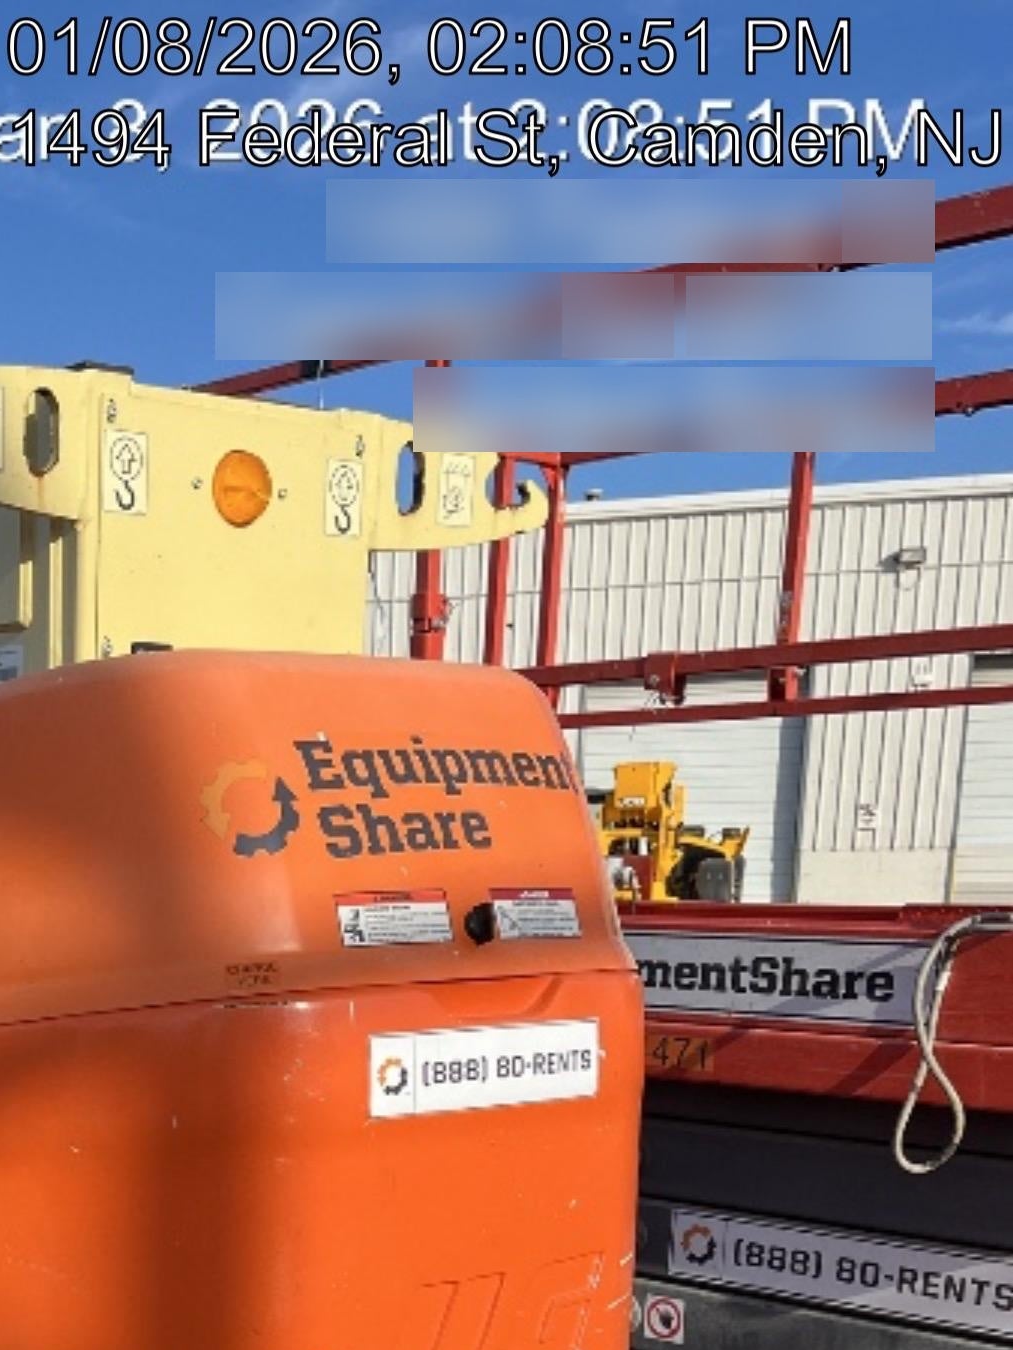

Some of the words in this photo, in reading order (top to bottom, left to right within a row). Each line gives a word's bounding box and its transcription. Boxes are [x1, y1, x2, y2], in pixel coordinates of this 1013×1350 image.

[293, 733, 579, 799] Equipmen
[316, 802, 493, 859] Share
[732, 1237, 823, 1289] (888)
[836, 1253, 1013, 1312] 80-RENTS
